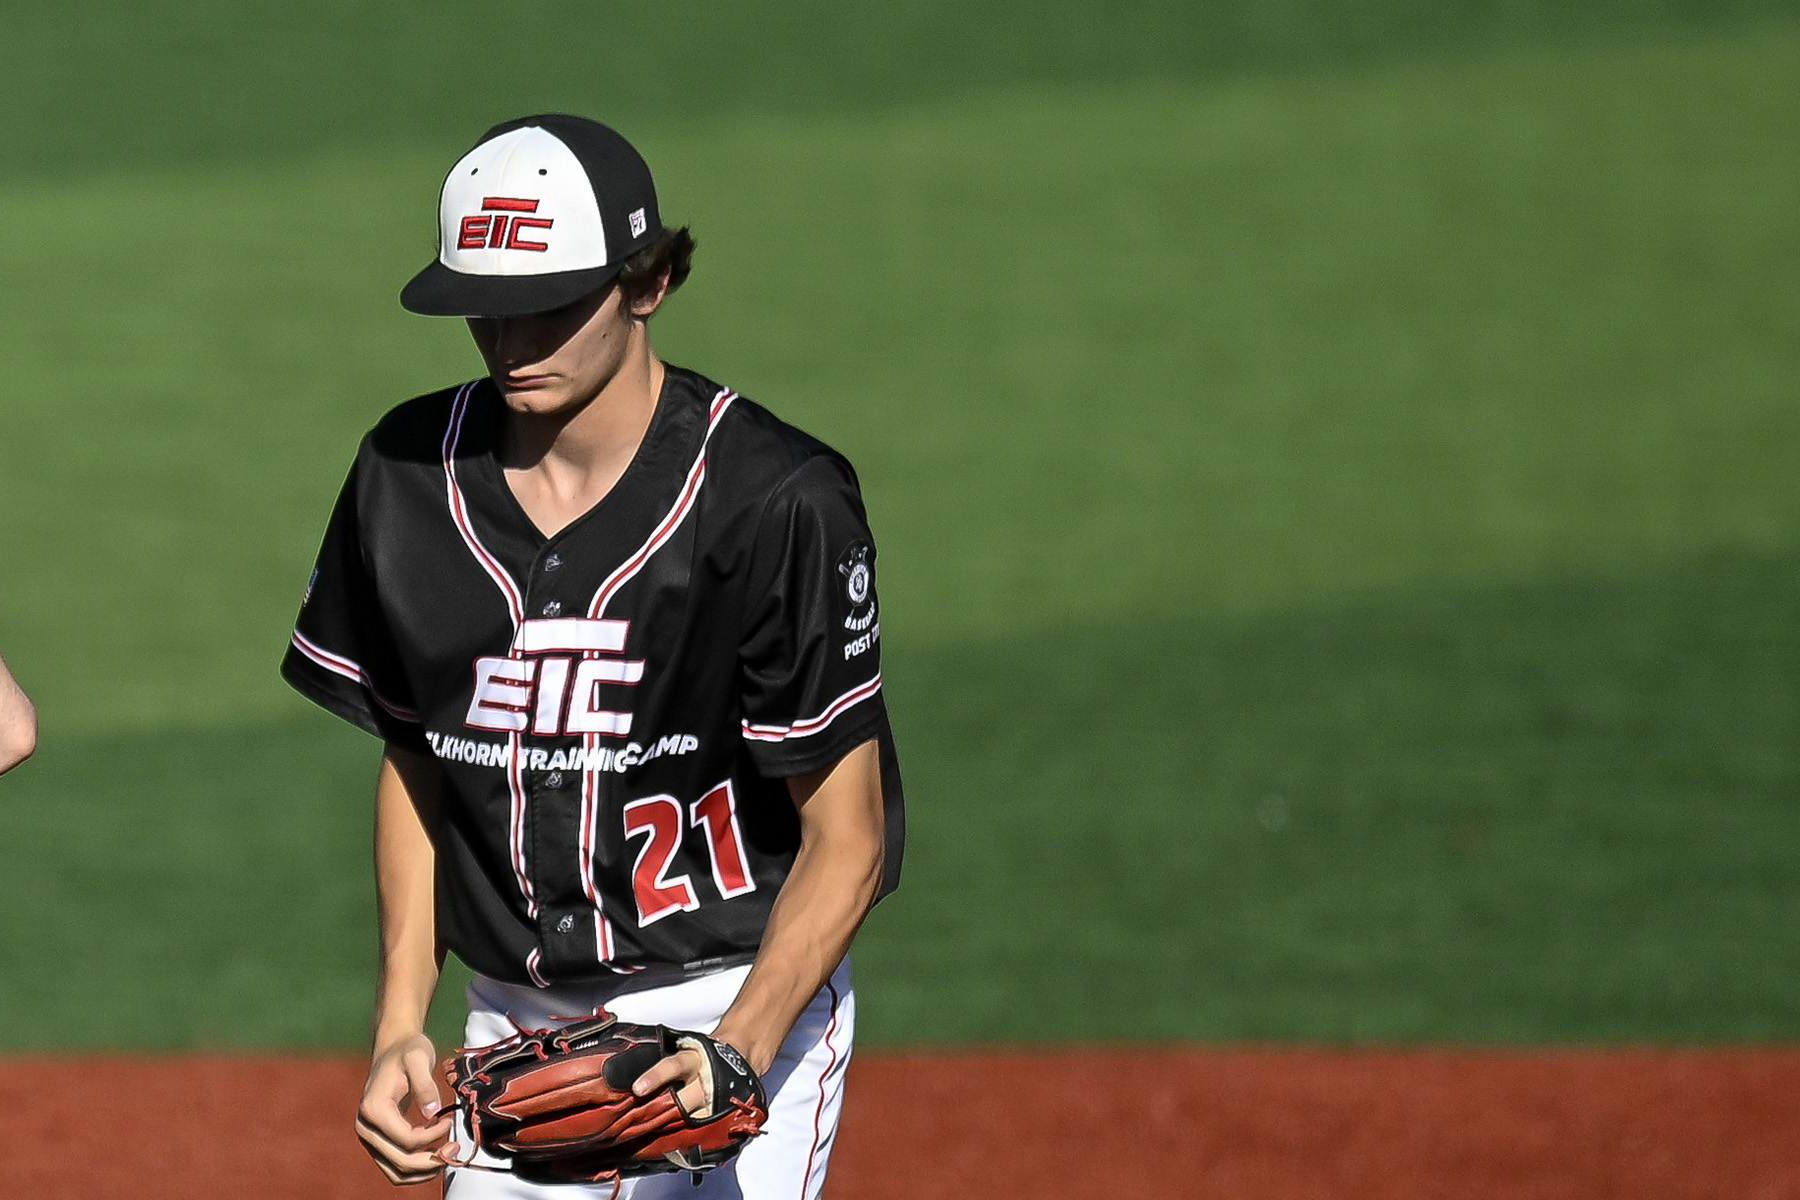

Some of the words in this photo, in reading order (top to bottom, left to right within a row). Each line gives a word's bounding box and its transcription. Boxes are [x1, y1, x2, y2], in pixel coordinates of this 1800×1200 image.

[844, 632, 871, 661] POST
[622, 733, 699, 766] CAMP
[623, 778, 757, 929] 21
